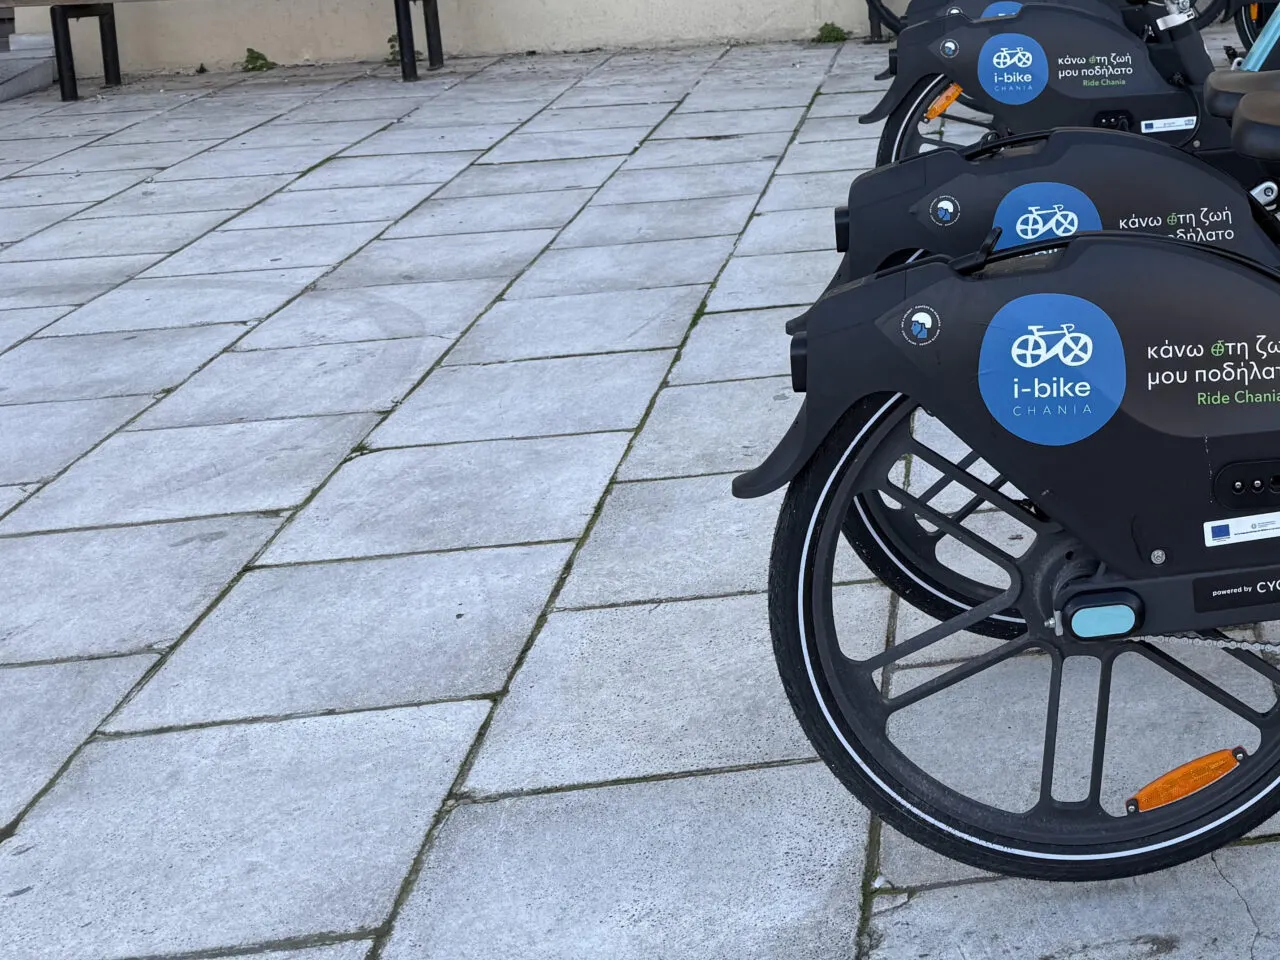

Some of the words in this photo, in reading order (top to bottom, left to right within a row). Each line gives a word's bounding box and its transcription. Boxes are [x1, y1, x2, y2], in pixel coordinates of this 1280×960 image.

[1058, 55, 1086, 65] κάνω
[1110, 53, 1132, 65] ζωή
[994, 72, 1032, 83] i-bike
[1058, 68, 1079, 80] μου
[1081, 65, 1134, 78] ποδήλατο
[1082, 79, 1099, 87] Ride
[1100, 78, 1126, 86] Chania
[1119, 214, 1162, 230] κάνω
[1200, 206, 1233, 226] ζωή
[1147, 340, 1204, 359] κάνω
[1148, 370, 1188, 390] μου
[1013, 377, 1091, 398] i-bike
[1197, 391, 1230, 405] Ride
[1012, 404, 1092, 416] CHANIA
[1212, 586, 1242, 597] powered
[1244, 585, 1253, 594] by
